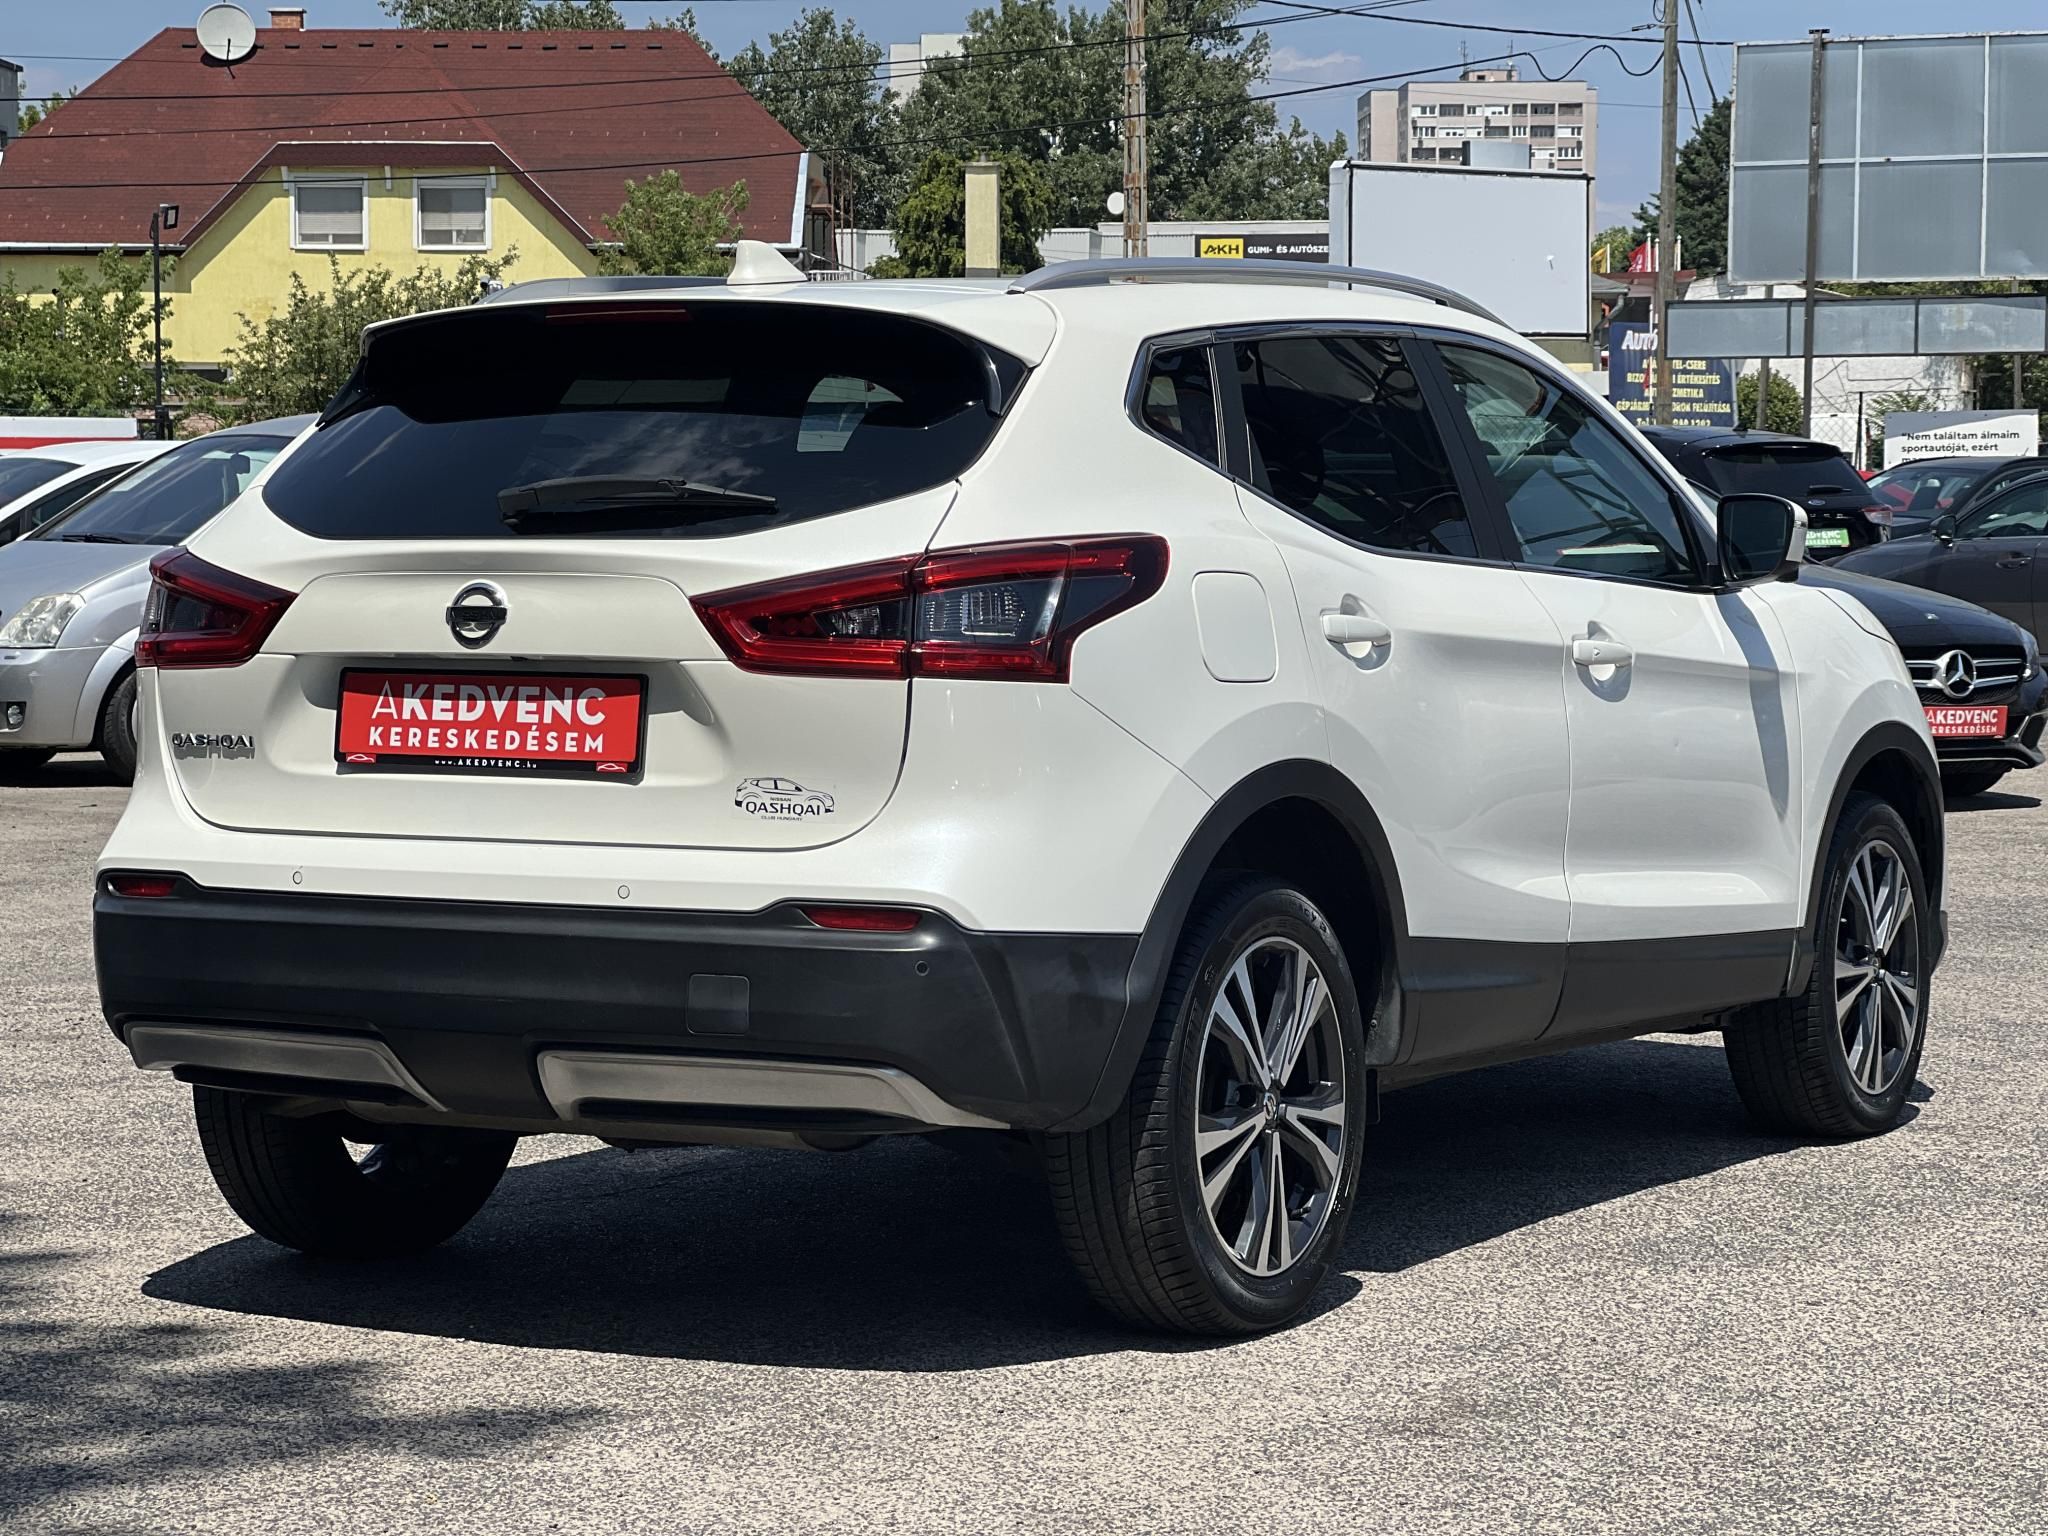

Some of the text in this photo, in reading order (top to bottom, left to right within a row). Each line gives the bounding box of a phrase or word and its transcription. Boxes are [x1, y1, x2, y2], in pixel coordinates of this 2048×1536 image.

[1203, 244, 1239, 254] AKH
[1276, 244, 1289, 253] ÉS
[1934, 431, 1978, 440] találtam
[1980, 430, 2020, 439] álmaim
[1901, 443, 1999, 454] sportautóját, ezért
[371, 680, 607, 726] AKEDVENC
[1927, 709, 1998, 723] AKEDVENC
[1932, 724, 1997, 733] ERESKEDÉSEM
[172, 733, 254, 749] QASHQAI
[368, 725, 604, 753] KERESKEDÉSEM
[434, 758, 538, 769] www.AKEDVENC.hu
[746, 802, 820, 816] QASHQAI
